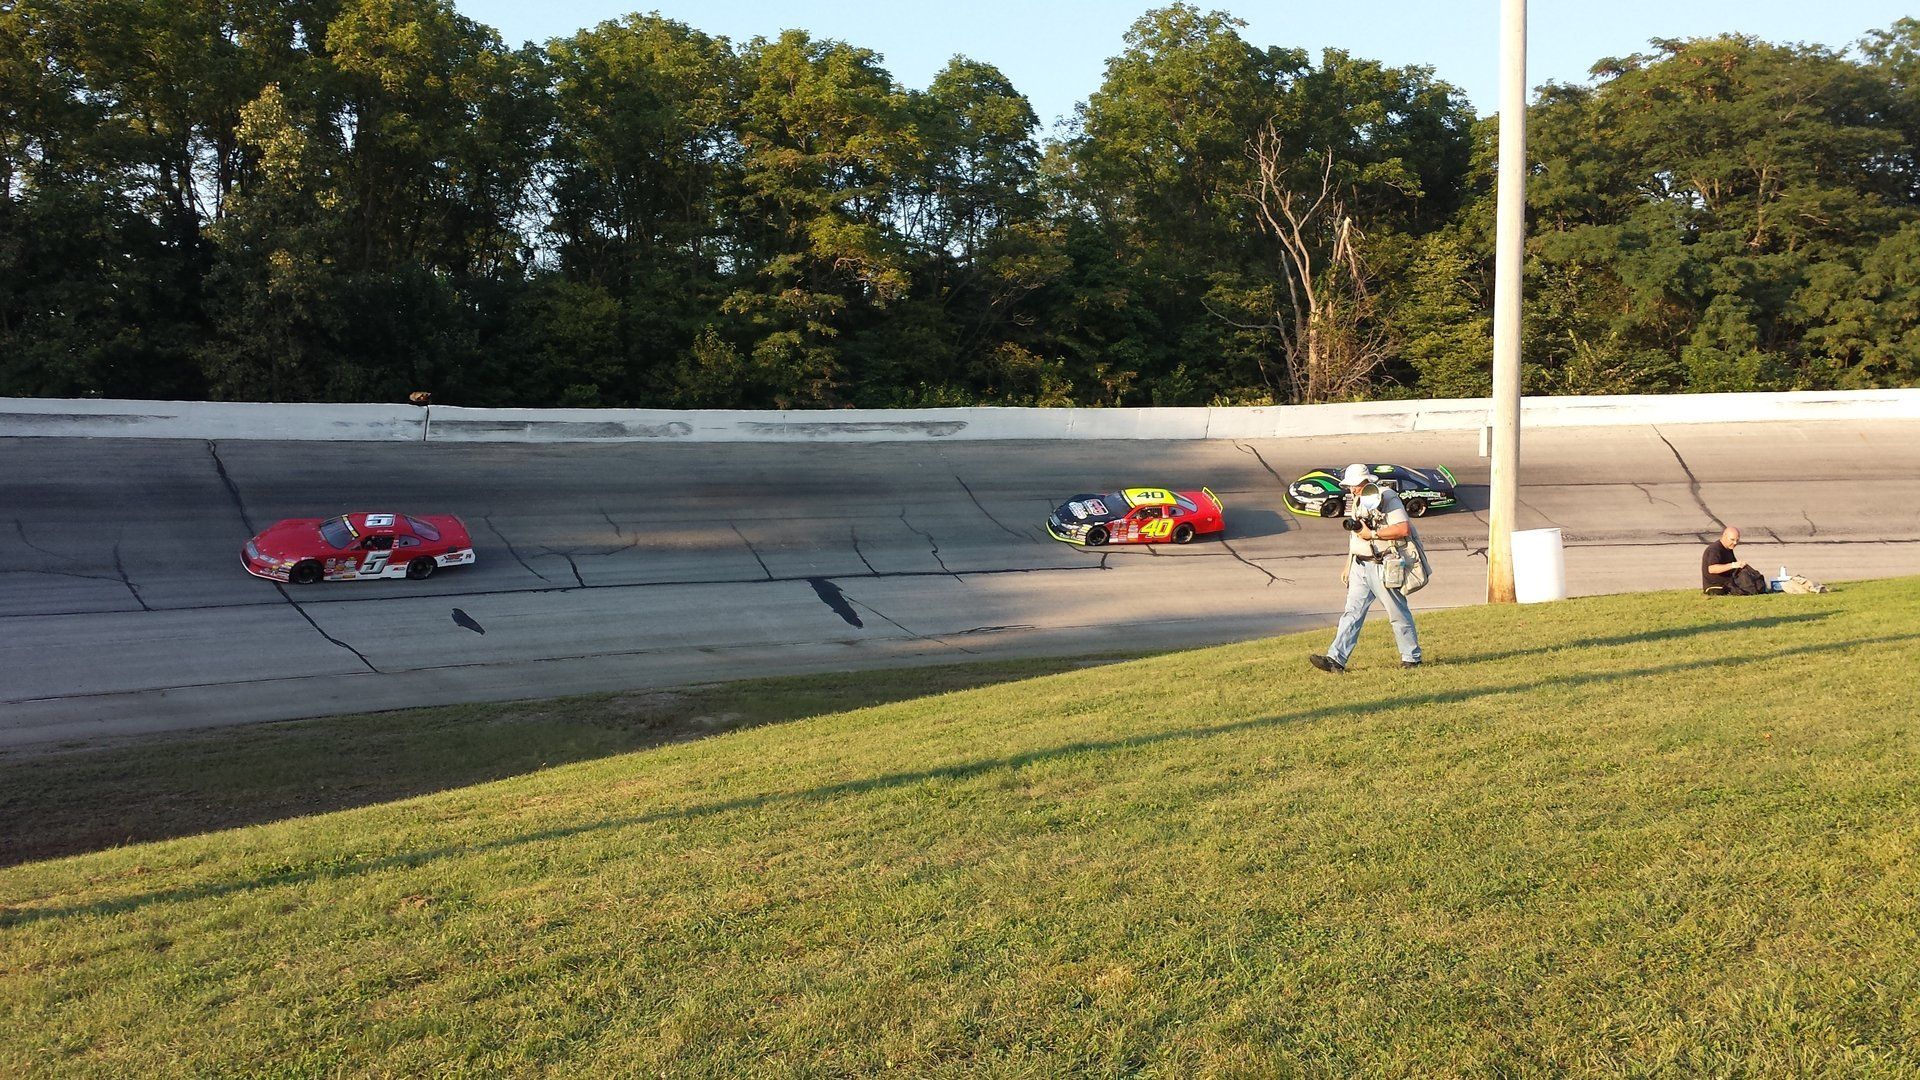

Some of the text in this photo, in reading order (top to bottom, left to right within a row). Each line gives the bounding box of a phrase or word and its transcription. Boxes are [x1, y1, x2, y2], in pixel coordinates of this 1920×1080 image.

[1137, 491, 1164, 499] 40
[365, 513, 395, 527] 5
[1139, 518, 1175, 538] 40
[359, 551, 392, 574] 5
